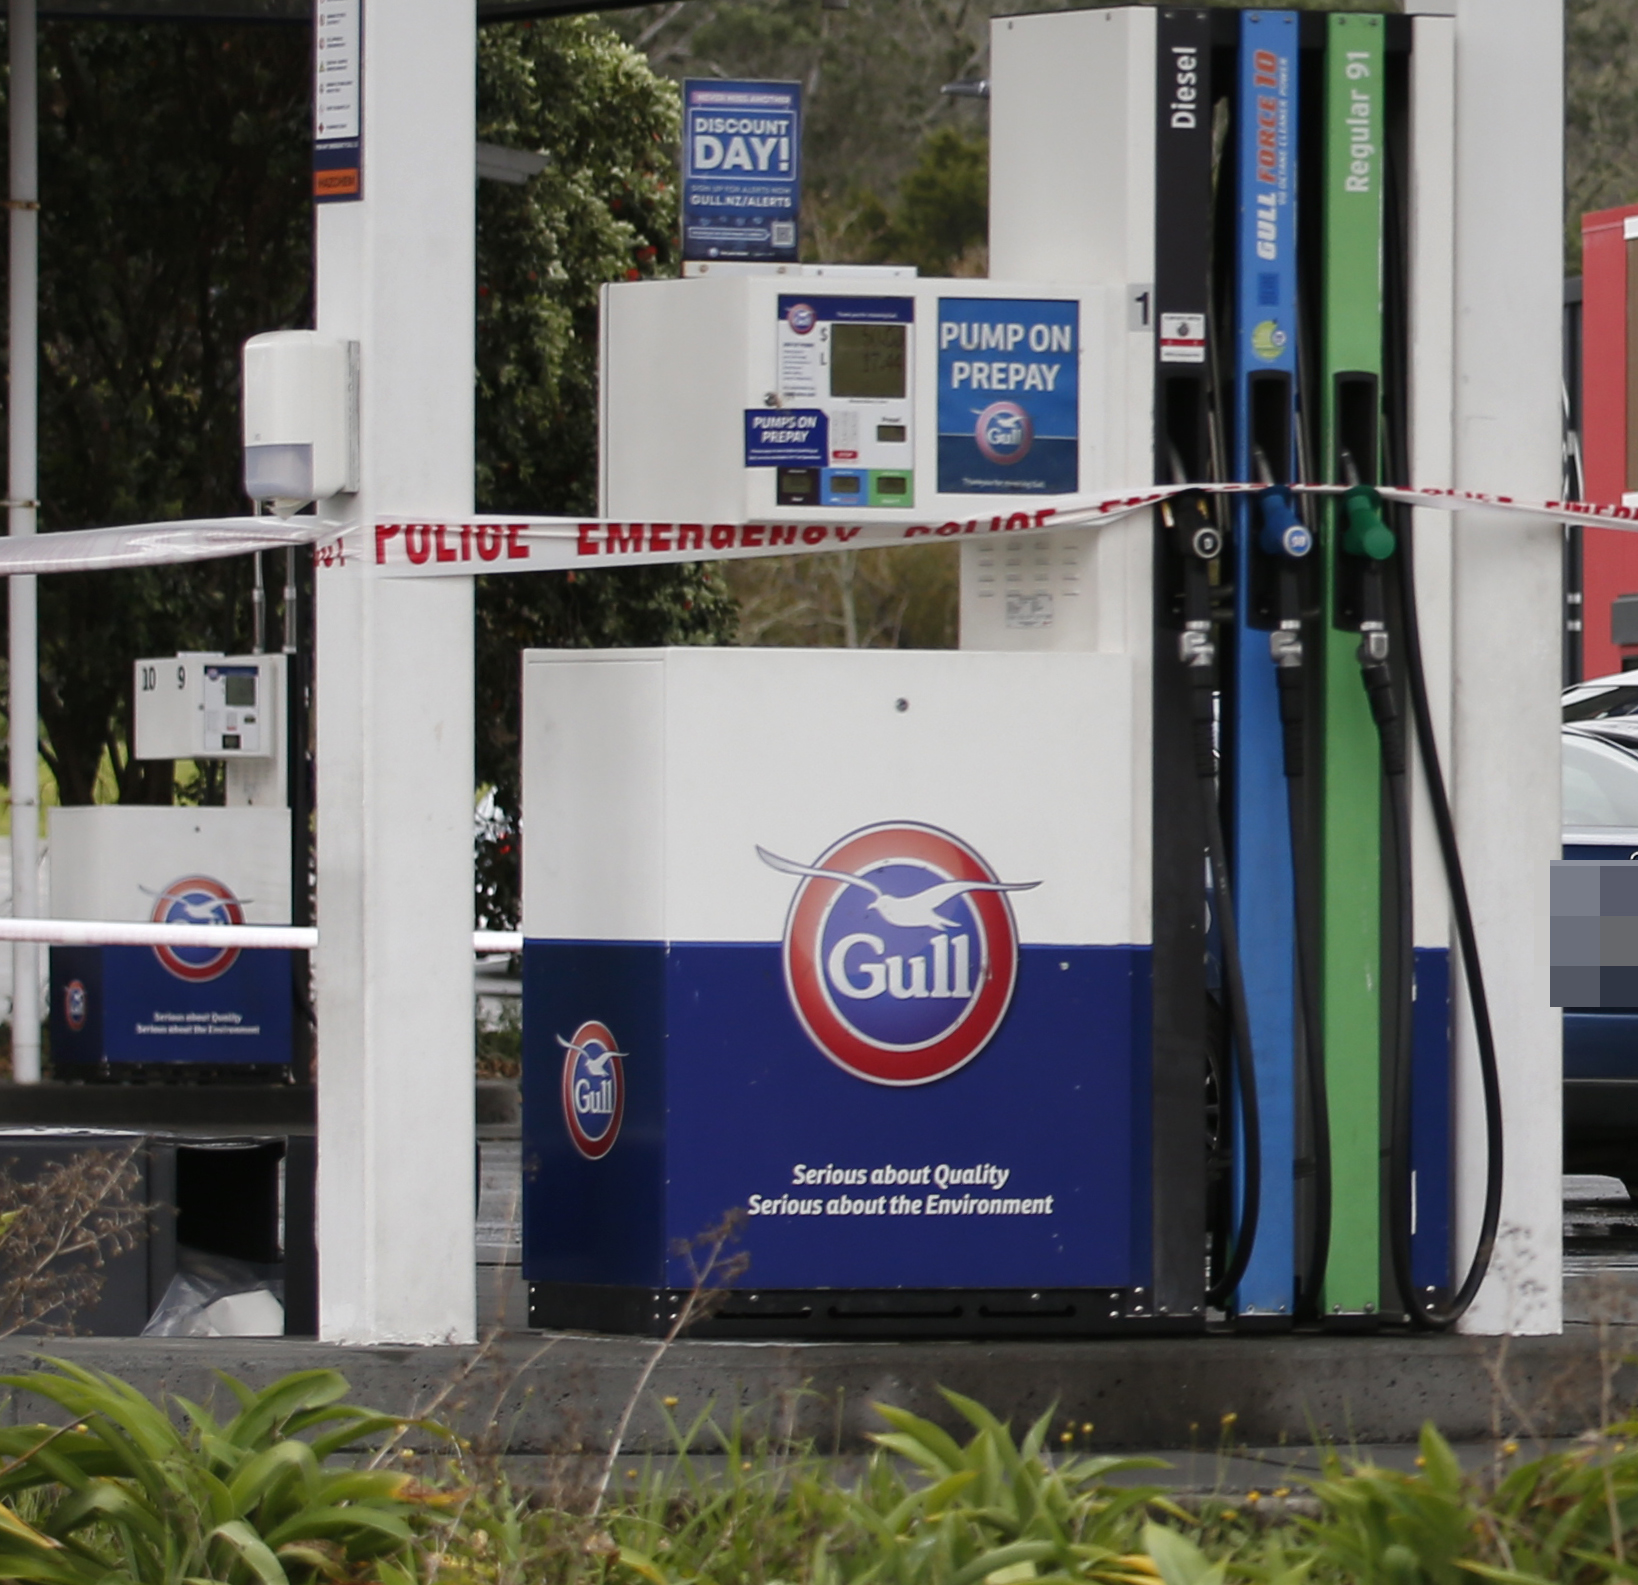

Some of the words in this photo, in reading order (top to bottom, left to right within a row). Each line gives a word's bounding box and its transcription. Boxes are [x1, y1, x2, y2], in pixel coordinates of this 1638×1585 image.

[1253, 48, 1278, 90] 10
[1345, 50, 1371, 80] 91
[1170, 46, 1198, 129] Diesel
[695, 117, 790, 135] DISCOUNT
[1256, 94, 1278, 184] FORCE
[1344, 88, 1375, 193] Regular
[694, 135, 791, 172] DAY!
[1256, 191, 1278, 261] GULL
[940, 321, 1025, 351] PUMP
[1028, 323, 1071, 352] ON
[952, 361, 1060, 391] PREPAY
[752, 416, 797, 429] PUMPS
[799, 417, 817, 429] ON
[761, 430, 810, 443] PREPAY
[142, 668, 156, 691] 10
[177, 667, 186, 689] 9
[824, 932, 971, 999] Gull
[575, 1078, 613, 1113] Gull
[792, 1163, 867, 1186] Serious
[871, 1163, 931, 1185] about
[934, 1163, 1010, 1190] Quality
[748, 1194, 823, 1216] Serious
[827, 1194, 887, 1215] about
[889, 1194, 922, 1215] the
[925, 1194, 1054, 1215] Environment
